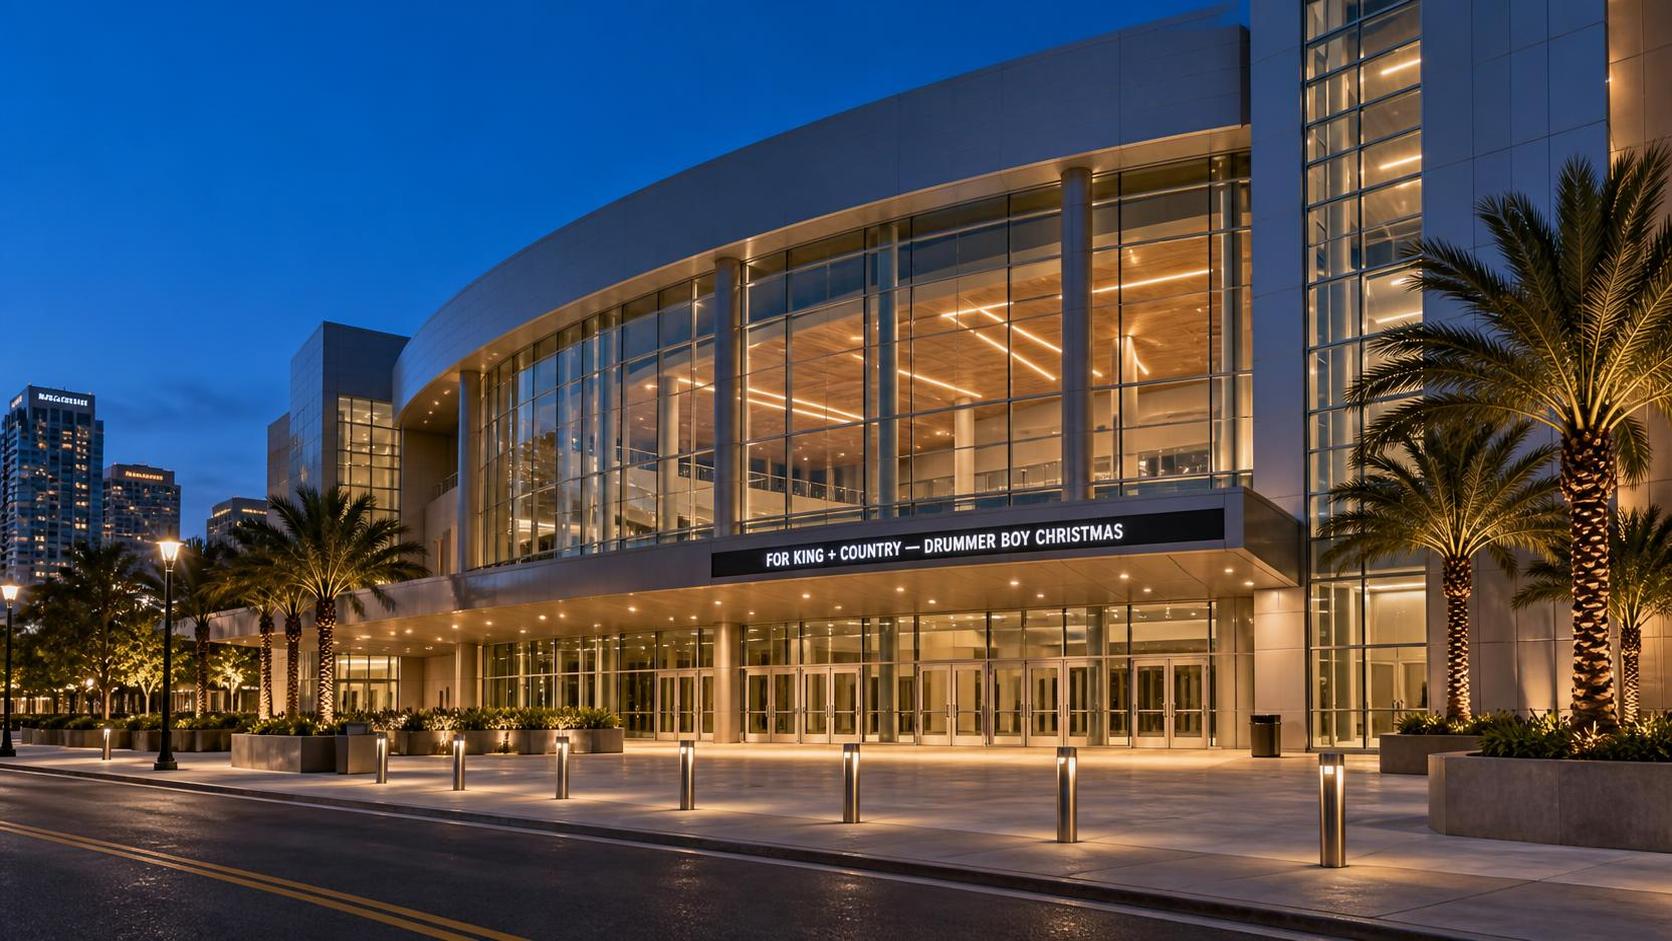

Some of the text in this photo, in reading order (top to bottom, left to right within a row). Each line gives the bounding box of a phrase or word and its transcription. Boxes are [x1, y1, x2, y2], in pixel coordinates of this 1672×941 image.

[765, 551, 790, 568] FOR
[793, 548, 825, 566] KING
[827, 549, 837, 560] +
[839, 540, 902, 562] COUNTRY
[924, 533, 996, 555] DRUMMER
[1001, 529, 1030, 549] BOY
[1035, 522, 1125, 546] CHRISTMAS
